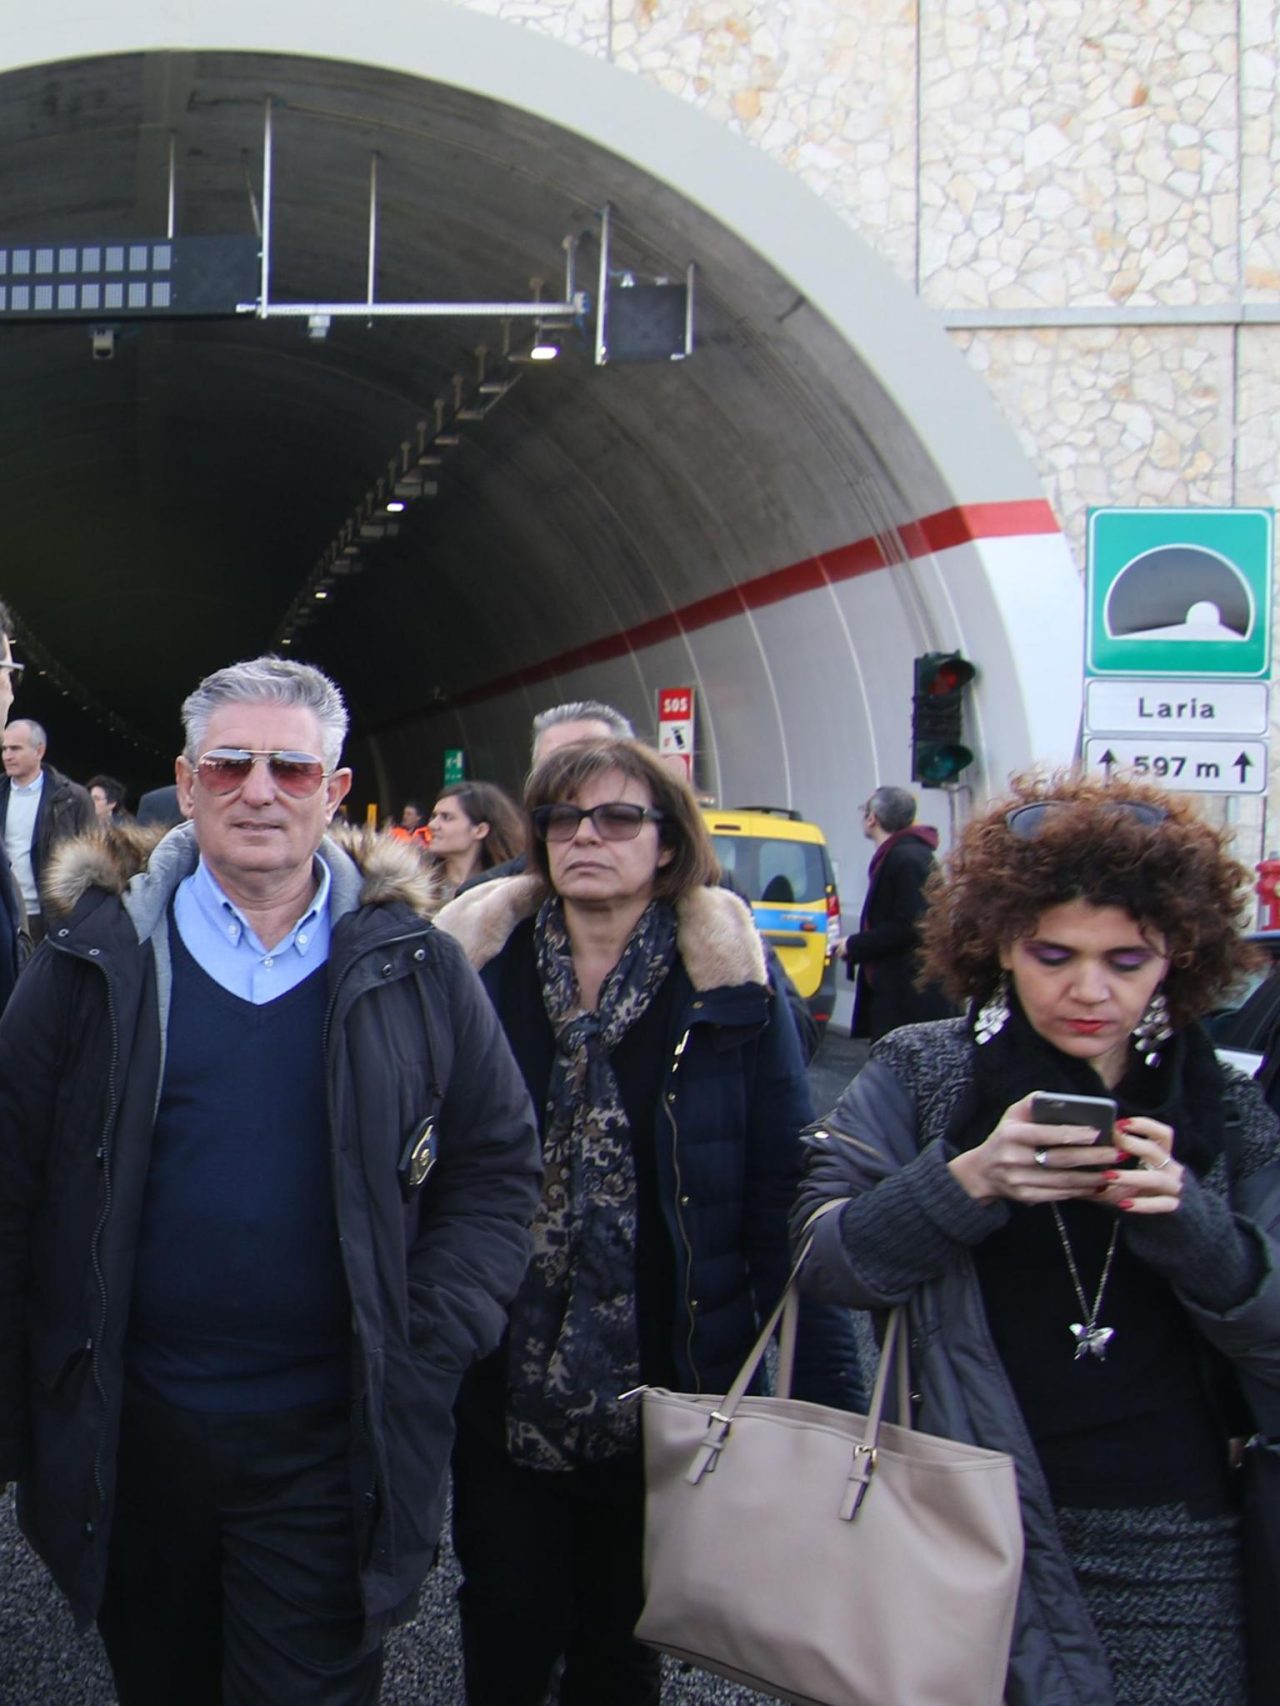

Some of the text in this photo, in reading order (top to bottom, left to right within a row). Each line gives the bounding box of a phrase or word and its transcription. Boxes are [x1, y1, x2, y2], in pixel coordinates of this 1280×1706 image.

[664, 697, 688, 713] SOS
[1138, 697, 1215, 719] Laria
[1133, 756, 1220, 778] 597 m
